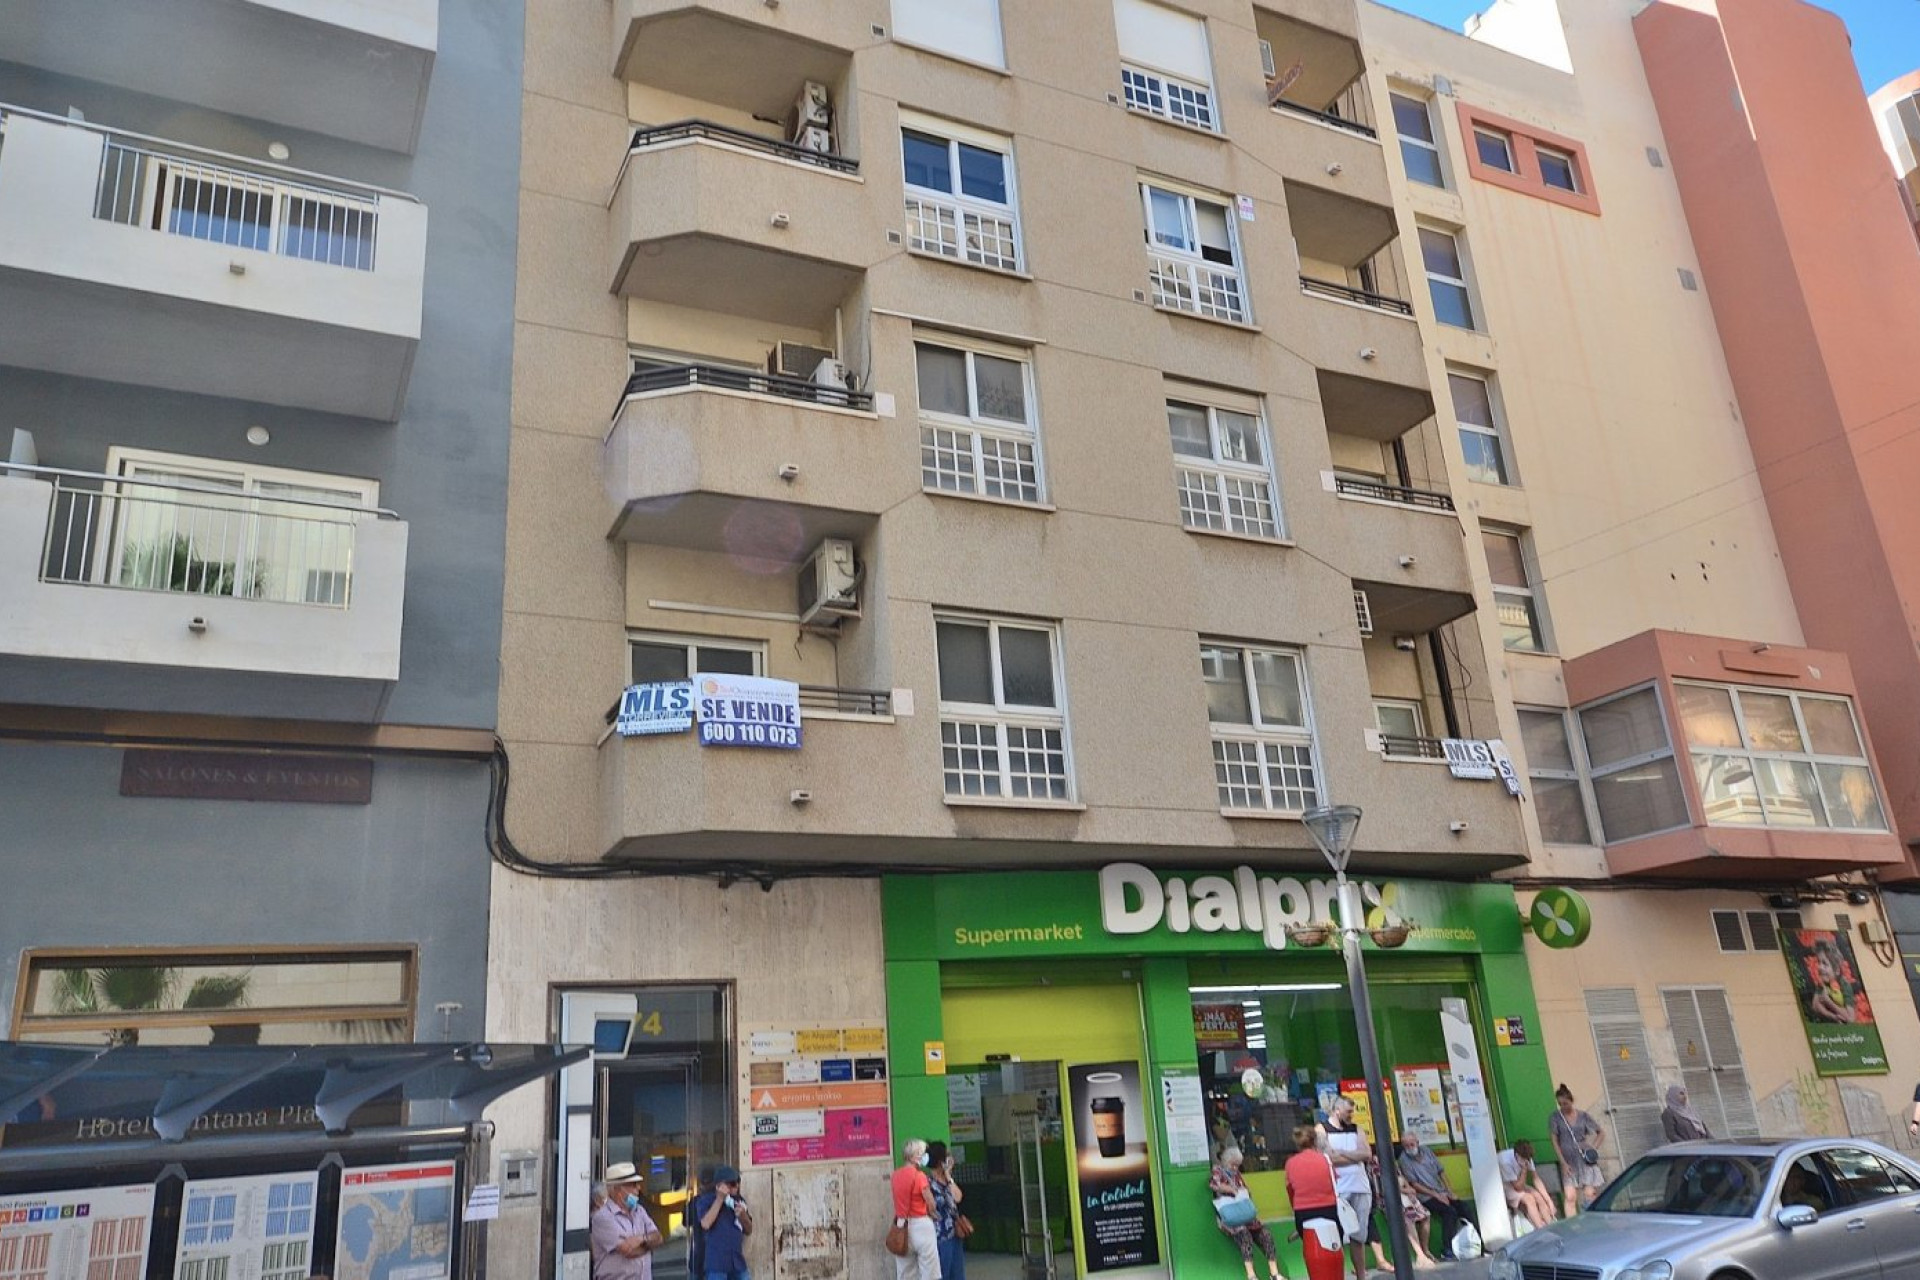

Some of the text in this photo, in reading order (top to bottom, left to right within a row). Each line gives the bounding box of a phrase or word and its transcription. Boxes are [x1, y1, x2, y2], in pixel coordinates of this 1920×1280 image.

[624, 688, 690, 714] MLS
[702, 699, 795, 724] SE VENDE
[703, 722, 735, 741] 600
[739, 724, 765, 742] 110
[769, 726, 797, 745] 073
[1445, 743, 1488, 762] MLS
[137, 766, 237, 784] SALONES
[243, 771, 258, 784] &
[955, 924, 1083, 947] Supermarket
[1407, 926, 1476, 941] upermercado
[76, 1115, 151, 1139] Hotel
[192, 1110, 268, 1131] ntana
[1101, 1179, 1144, 1204] Calidad
